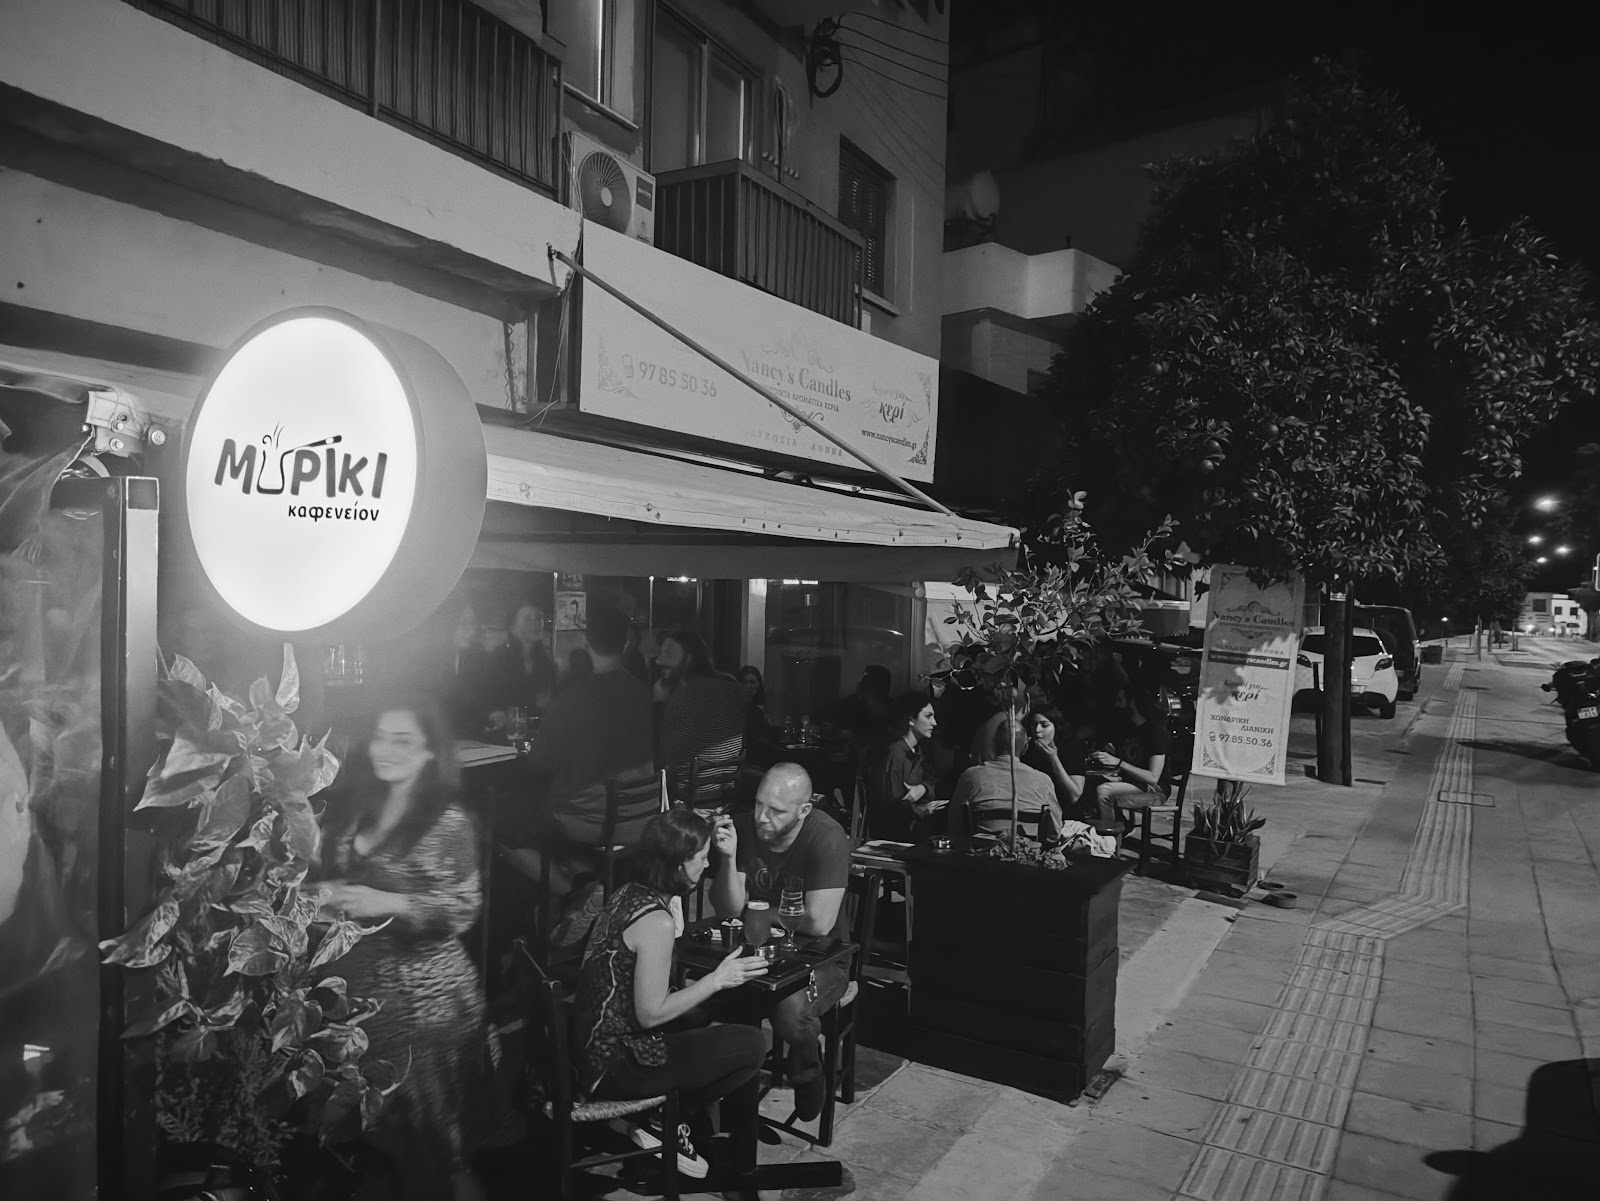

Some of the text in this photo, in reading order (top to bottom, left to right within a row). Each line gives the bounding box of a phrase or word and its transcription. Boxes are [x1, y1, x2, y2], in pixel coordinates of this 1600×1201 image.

[639, 361, 717, 398] 97 85 50 36
[798, 367, 852, 402] Candles
[288, 501, 380, 523] καφενείον
[1210, 714, 1249, 724] ΧΟΝΔΡΙΚΗ
[1240, 725, 1274, 735] ΛΙΑΝΙΚΗ
[1218, 733, 1273, 748] 97.85.50.36
